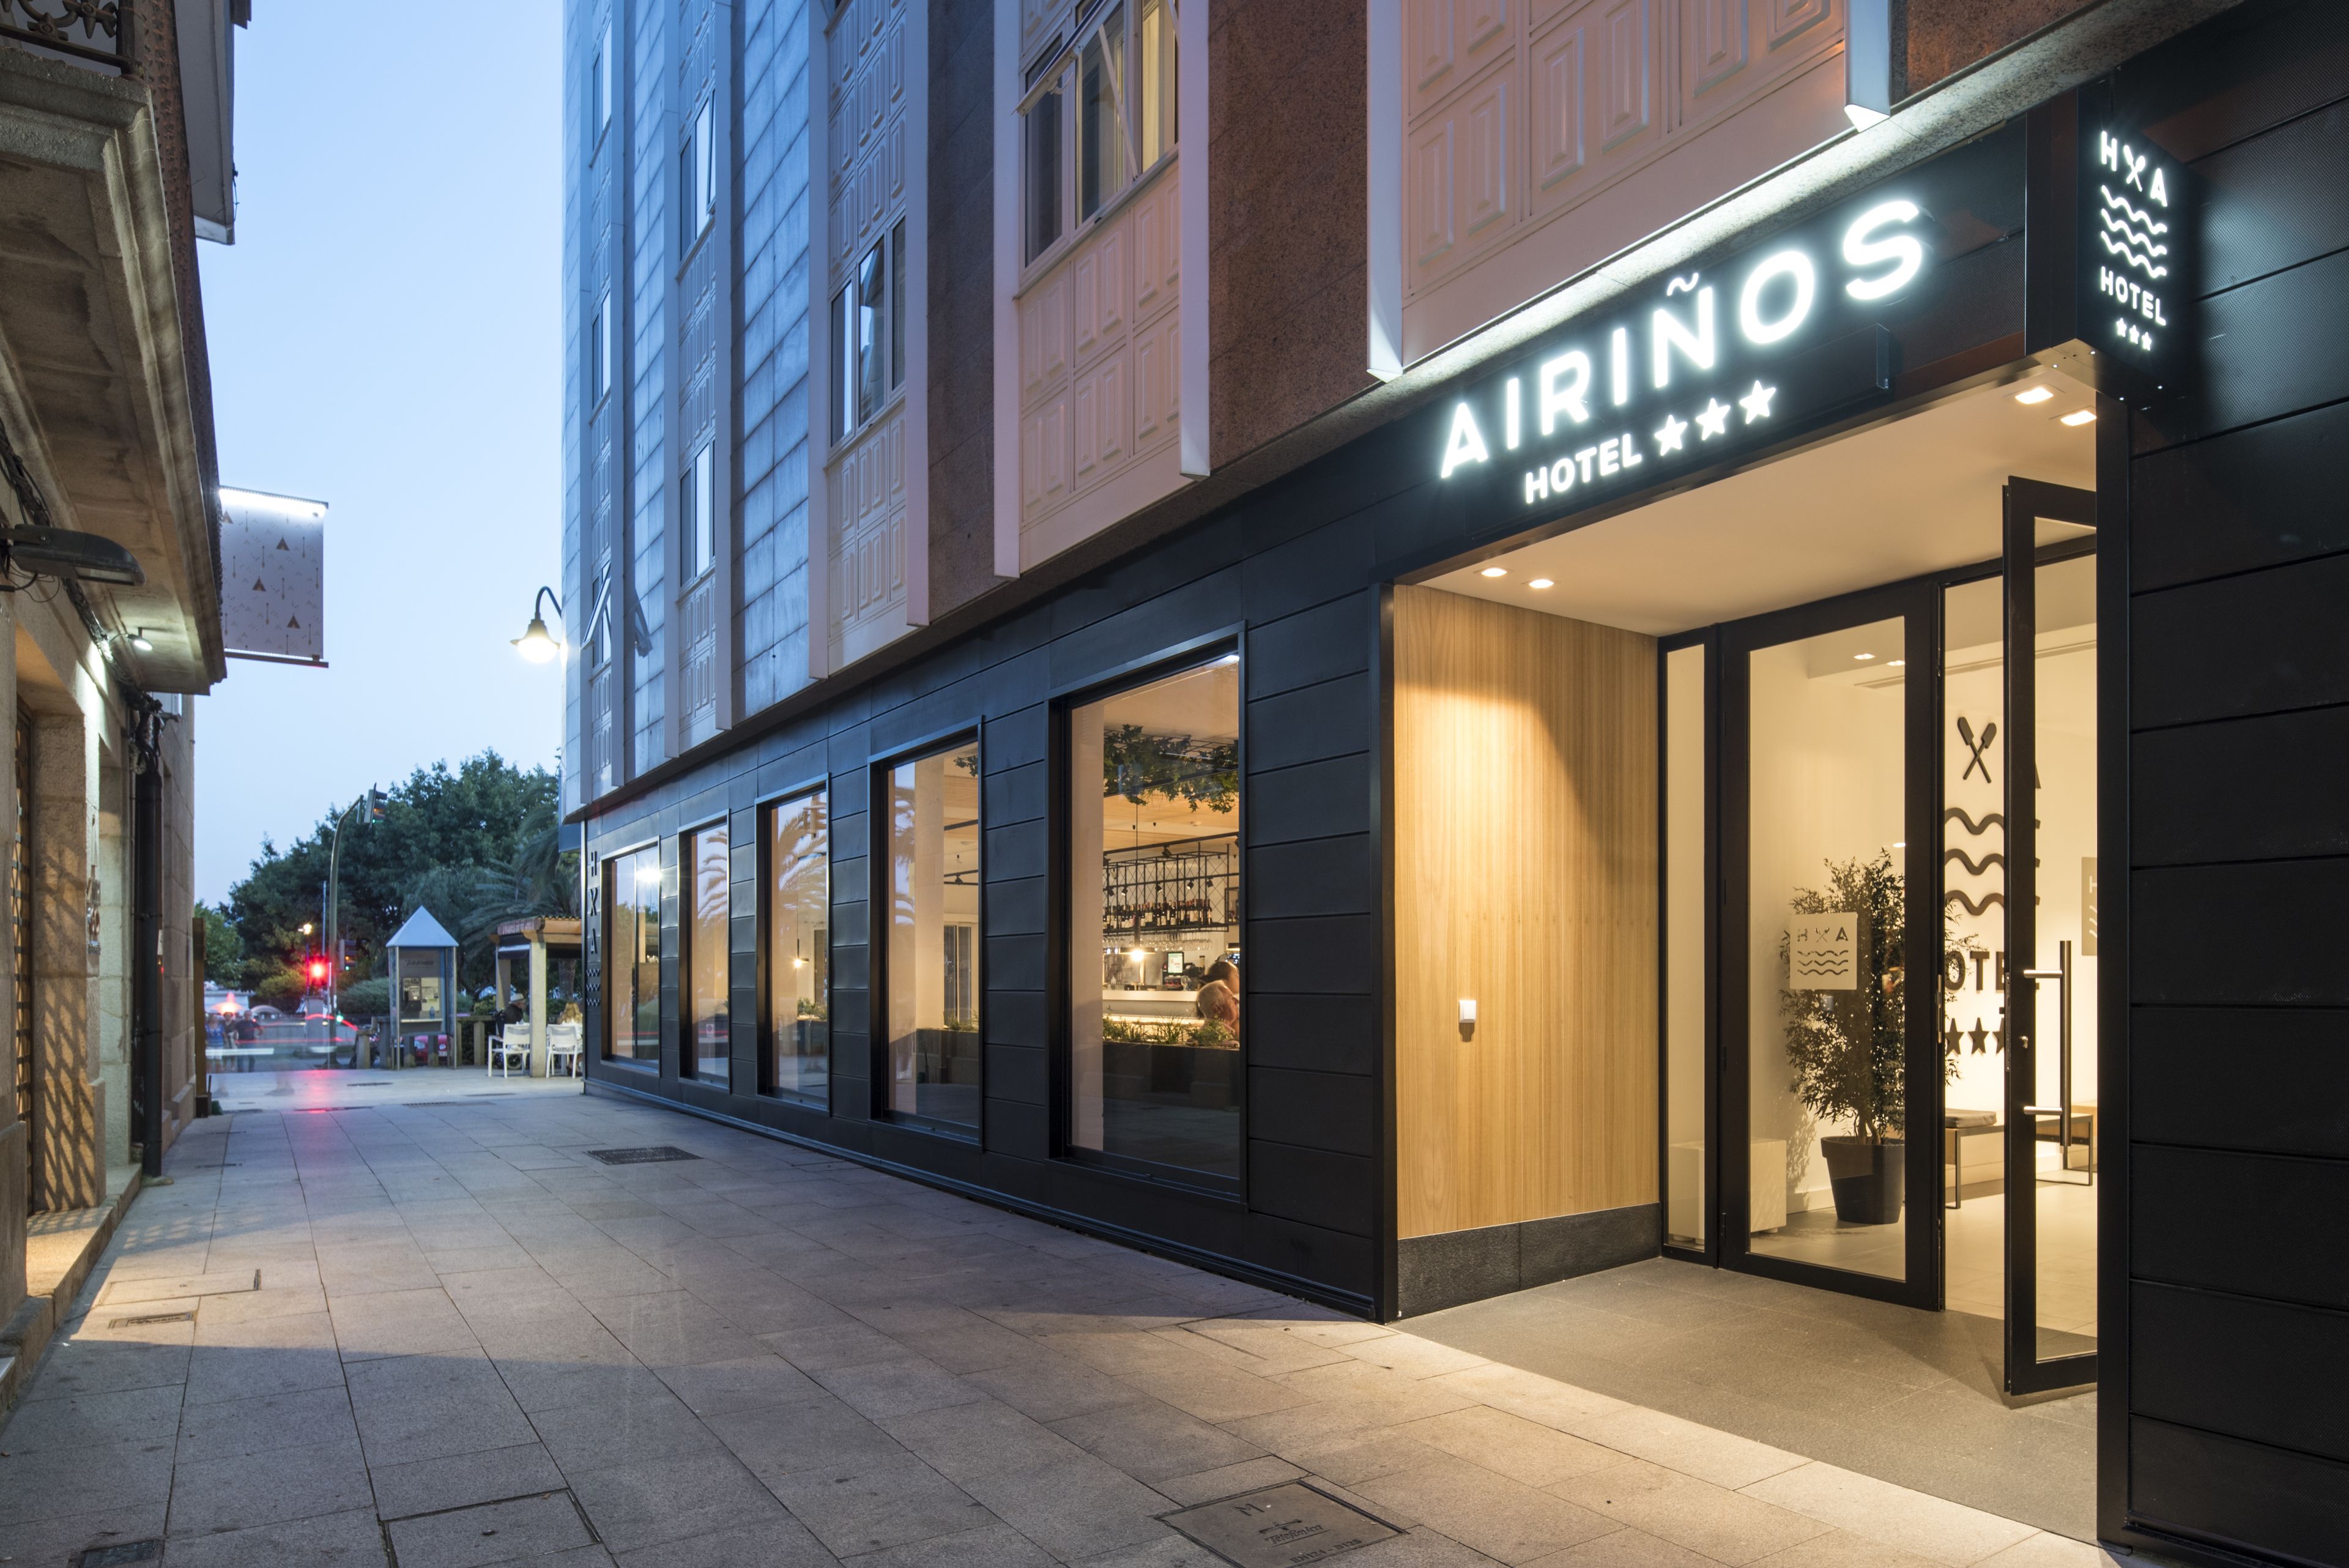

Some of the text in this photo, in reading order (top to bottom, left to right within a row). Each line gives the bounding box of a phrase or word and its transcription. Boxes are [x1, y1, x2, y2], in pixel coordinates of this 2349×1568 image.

[2101, 266, 2167, 327] HOTEL
[1439, 200, 1924, 480] AIRIÑOS
[1525, 433, 1643, 505] HOTEL
